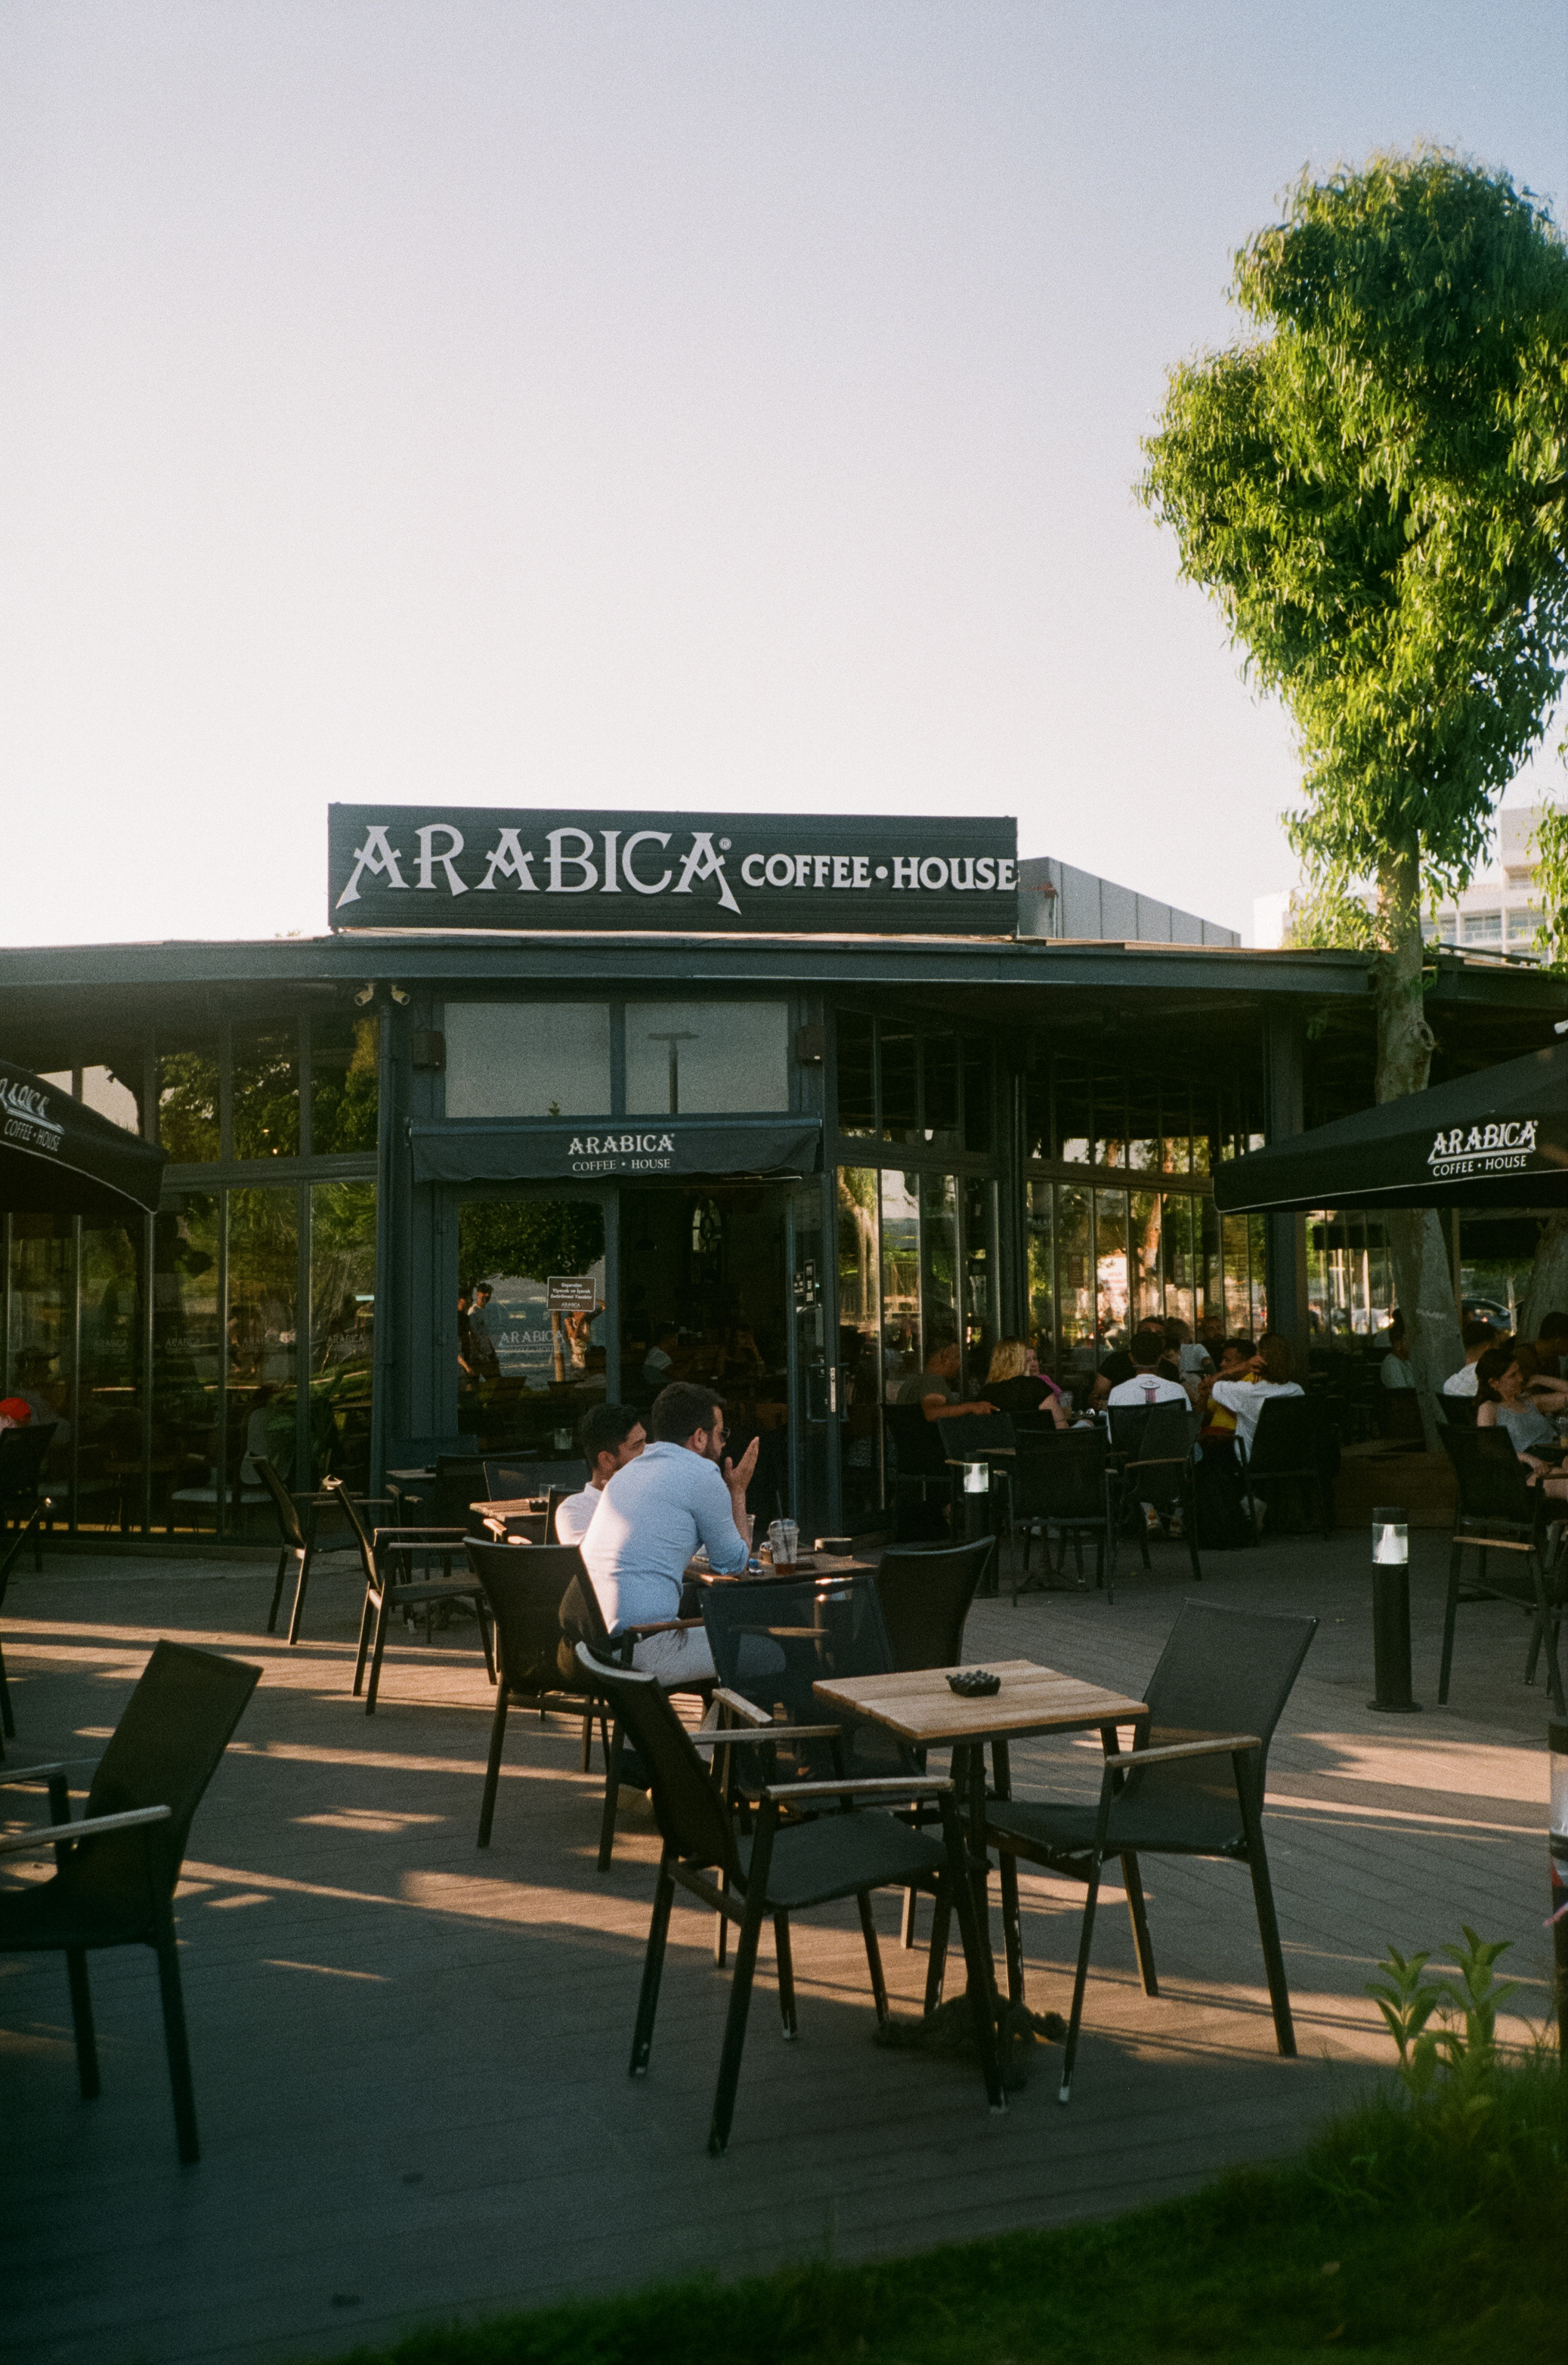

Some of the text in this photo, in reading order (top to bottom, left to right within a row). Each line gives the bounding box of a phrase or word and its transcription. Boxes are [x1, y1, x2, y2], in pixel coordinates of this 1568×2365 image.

[5, 1119, 60, 1152] COFFEE HOUSE
[572, 1158, 670, 1171] COFFEE HOUSE
[1433, 1155, 1526, 1176] COFFEE HOUSE
[499, 1330, 565, 1346] ARABICA
